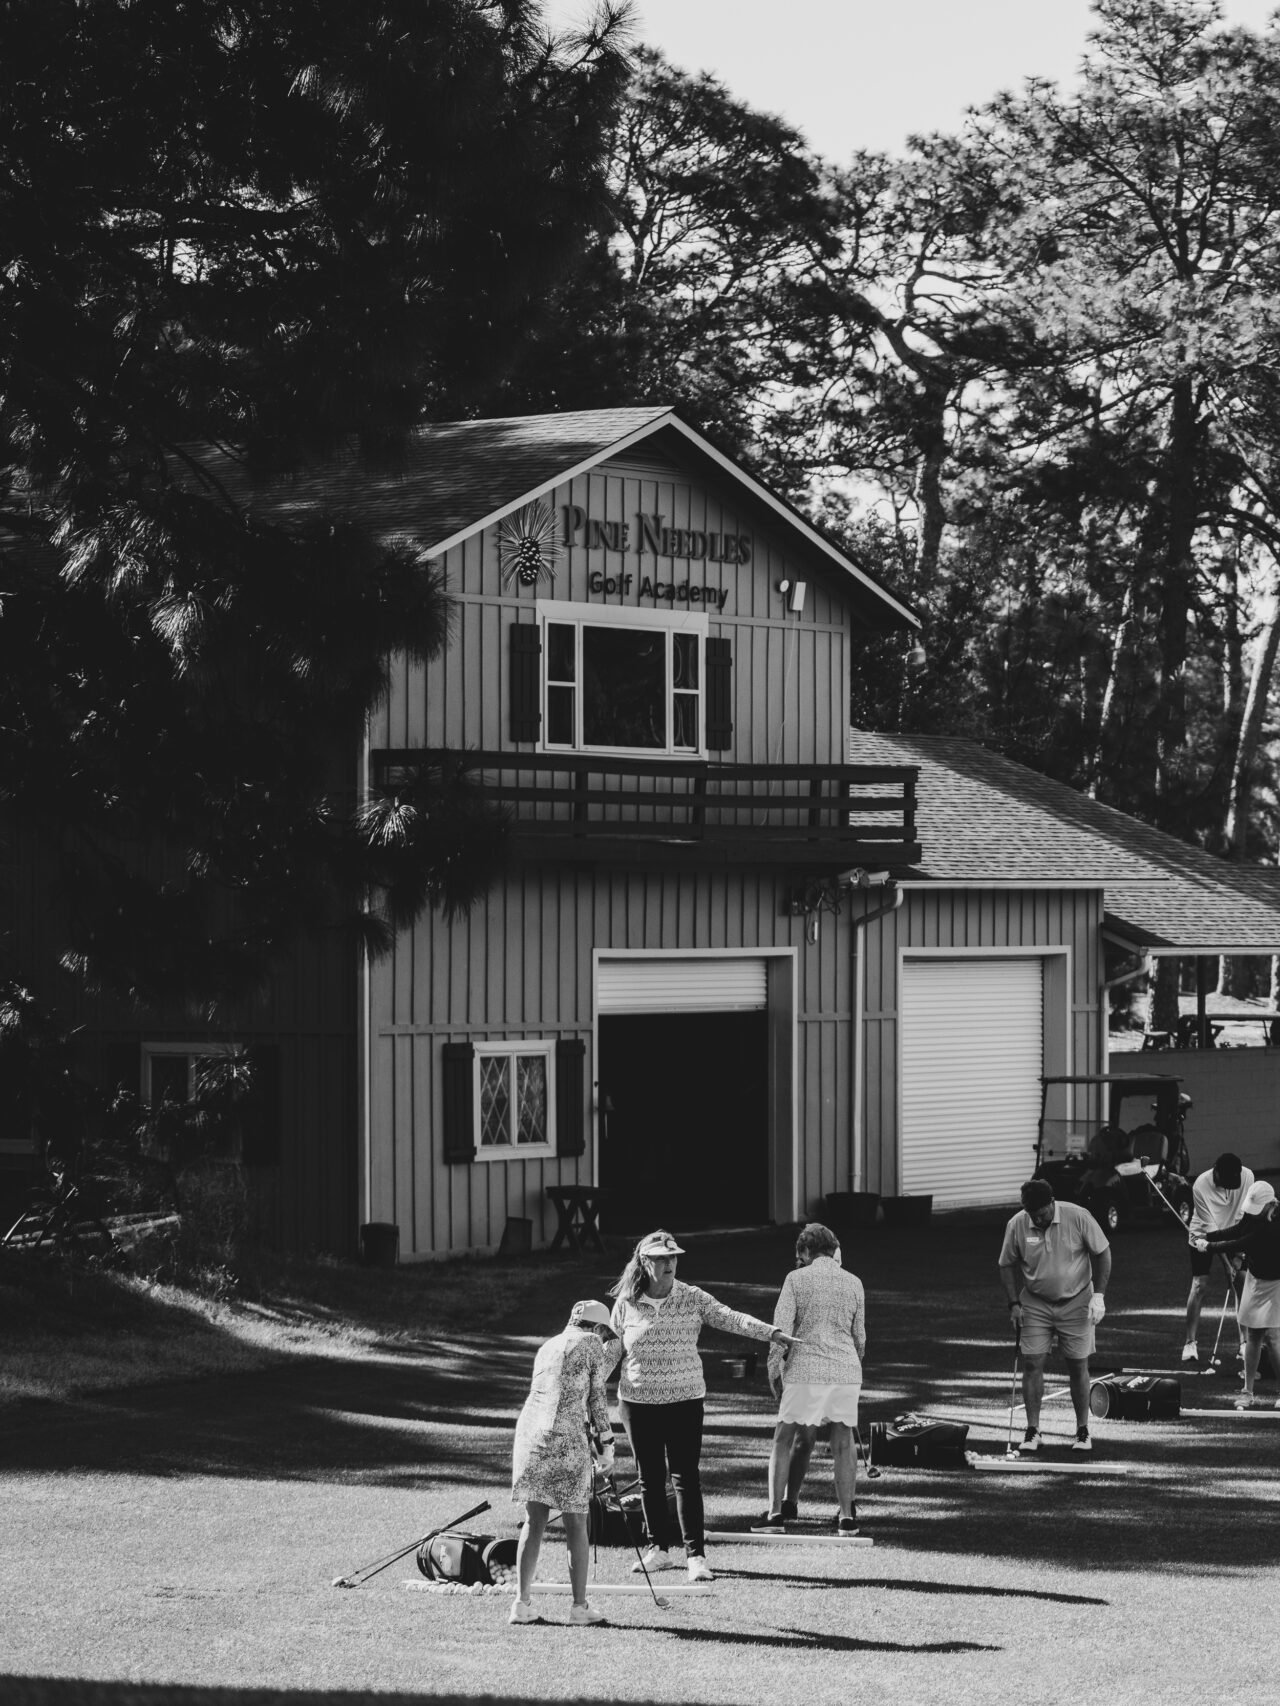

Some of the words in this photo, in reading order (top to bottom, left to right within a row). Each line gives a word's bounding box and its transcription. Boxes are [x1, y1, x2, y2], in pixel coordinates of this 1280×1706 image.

[563, 504, 631, 552] PINE
[635, 513, 751, 565] NEEDLES
[590, 571, 632, 596] Golf
[640, 576, 729, 608] Academy
